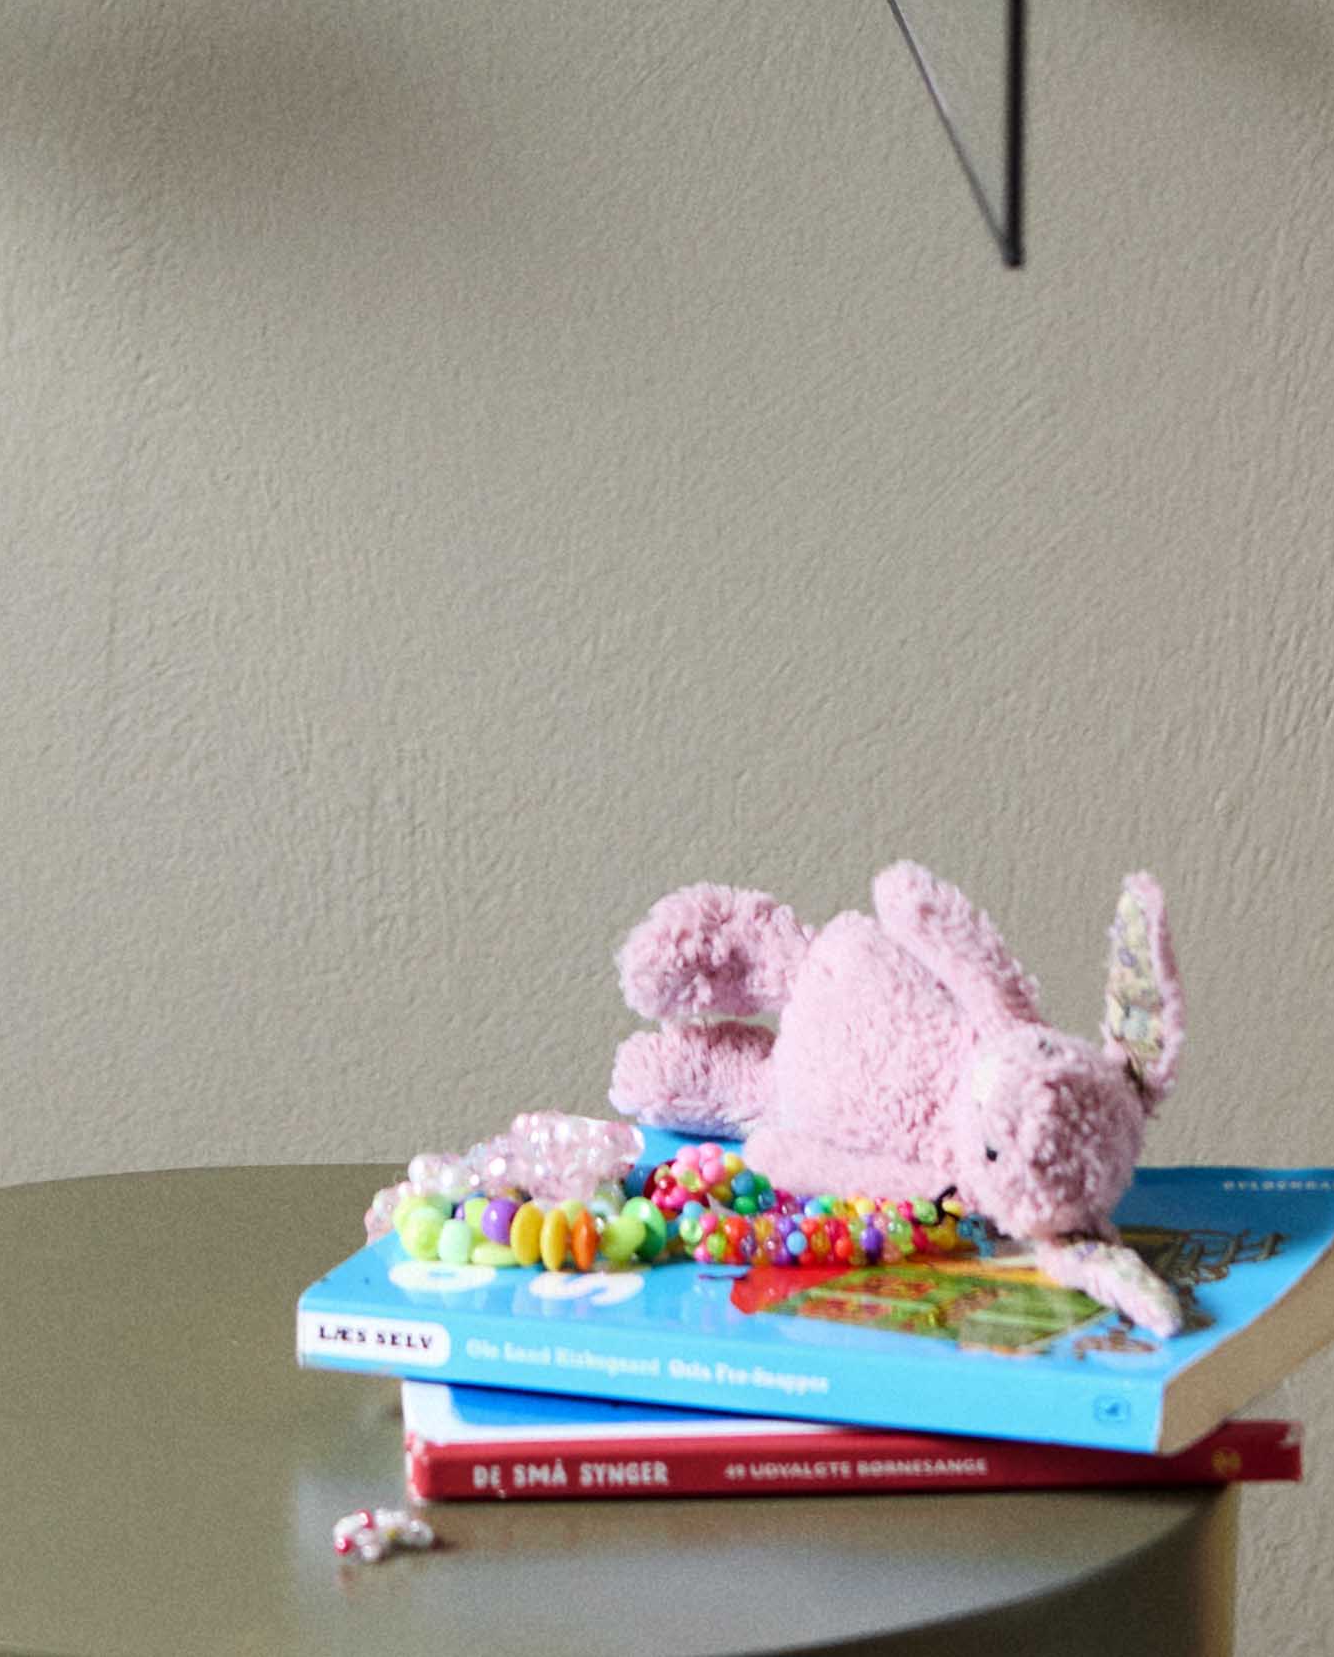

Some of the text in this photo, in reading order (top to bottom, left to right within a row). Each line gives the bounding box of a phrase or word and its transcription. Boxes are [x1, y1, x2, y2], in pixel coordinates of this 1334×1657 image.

[318, 1325, 433, 1350] LÆS SELV
[473, 1457, 667, 1489] DE SMÅ SYNGER
